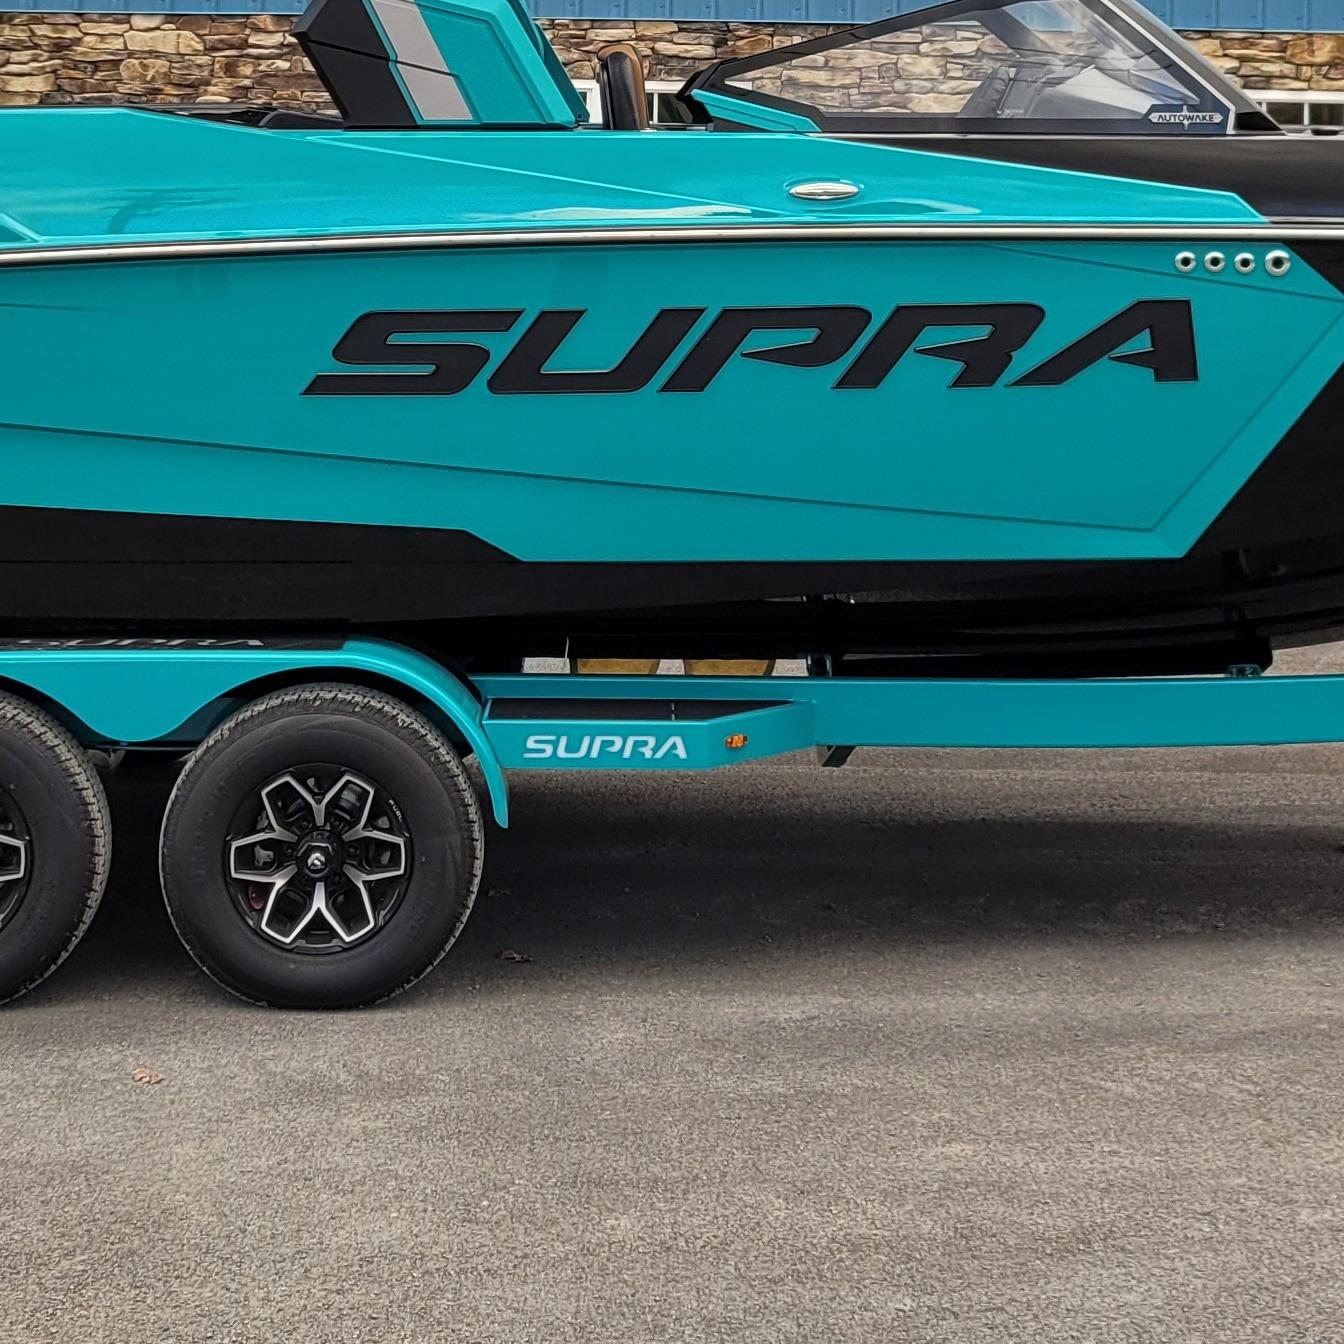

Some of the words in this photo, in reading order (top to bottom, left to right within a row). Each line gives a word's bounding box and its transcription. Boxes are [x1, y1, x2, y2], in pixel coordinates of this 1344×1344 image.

[1156, 114, 1215, 122] AUTOWAKE
[302, 299, 1199, 397] SUPRA
[522, 735, 688, 759] SUPRA
